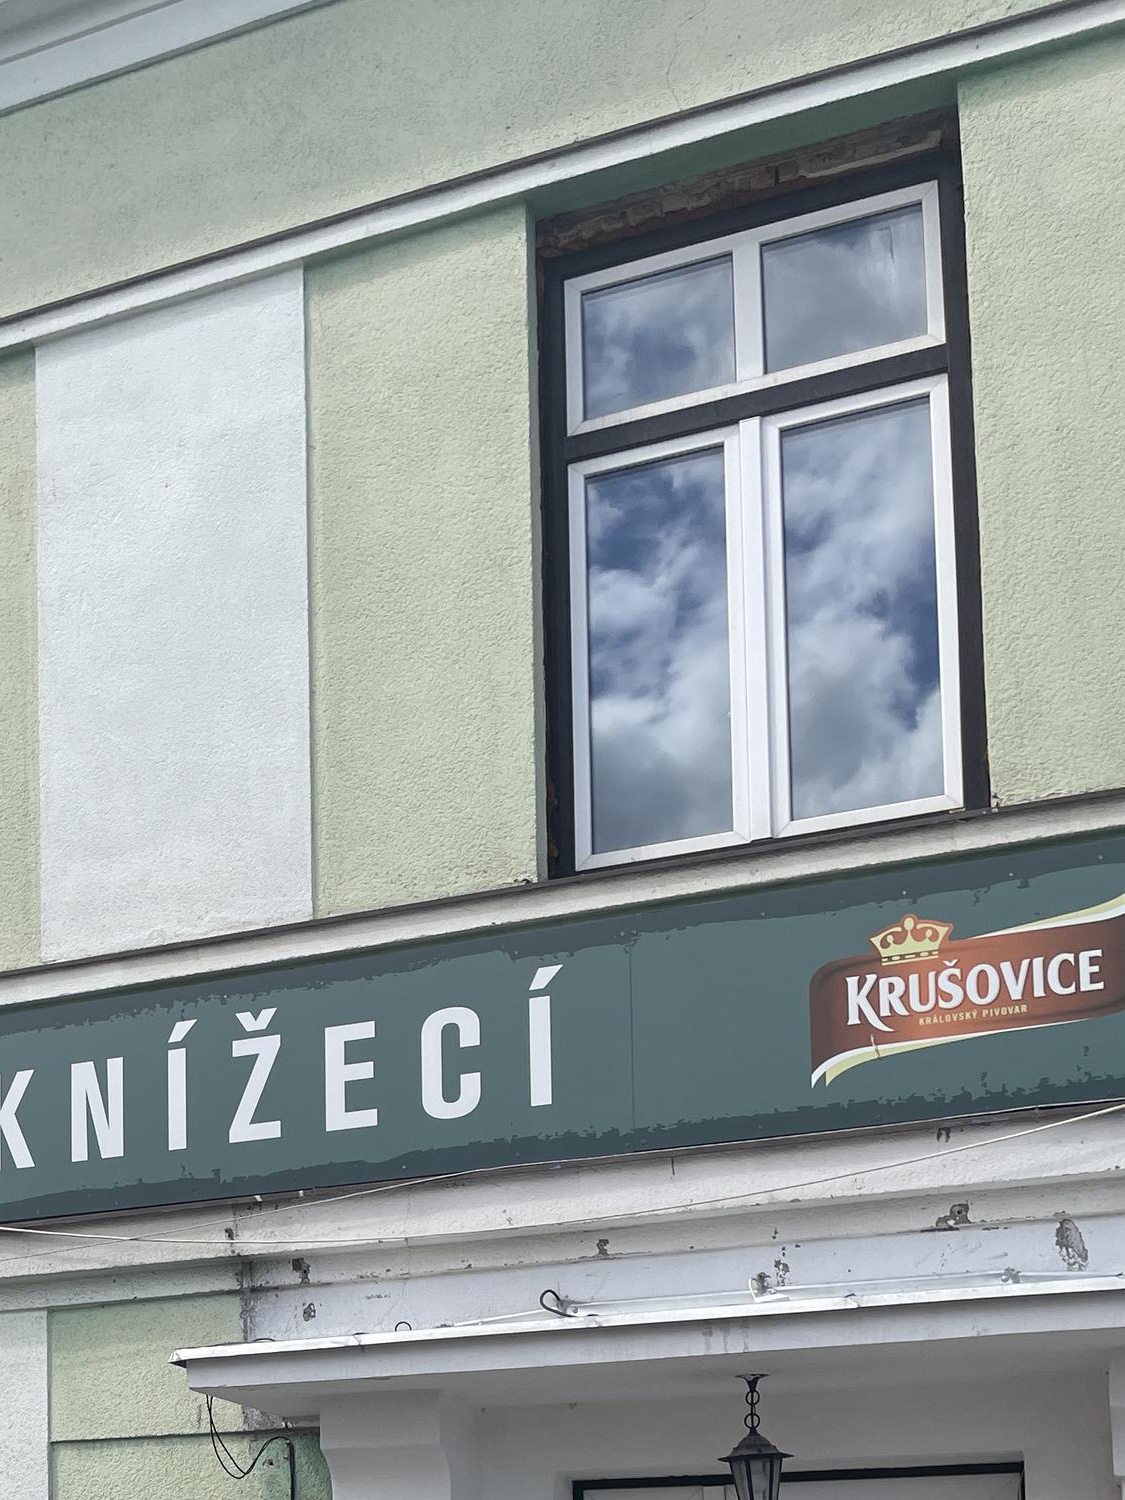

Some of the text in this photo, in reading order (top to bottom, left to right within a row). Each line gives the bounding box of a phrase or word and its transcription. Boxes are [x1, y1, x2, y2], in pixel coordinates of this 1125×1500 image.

[845, 949, 1105, 1032] KRUŠOVICE
[918, 1004, 1028, 1026] KRÁLOVSKÝ PIVOVAR
